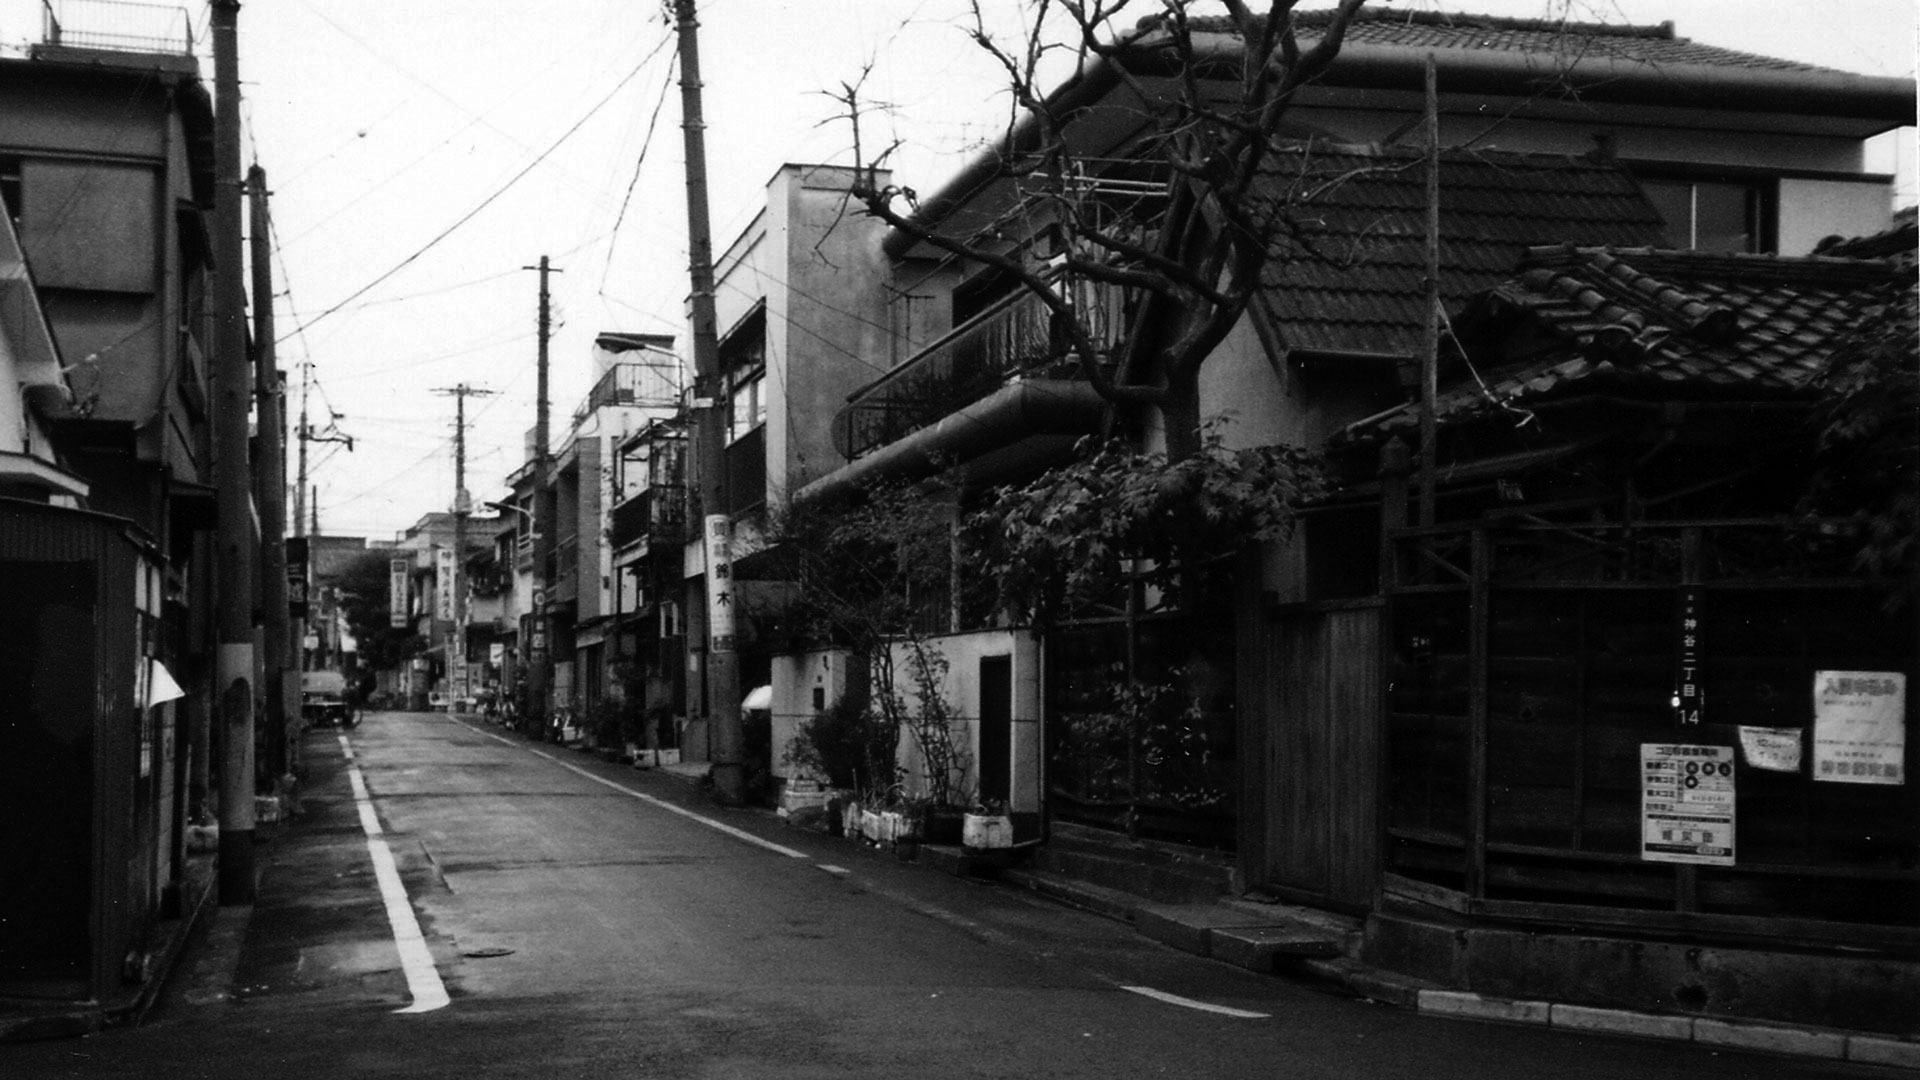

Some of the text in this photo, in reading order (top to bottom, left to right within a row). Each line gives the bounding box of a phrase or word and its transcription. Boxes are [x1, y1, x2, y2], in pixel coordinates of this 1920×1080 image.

[715, 562, 731, 607] 鈴木
[1683, 618, 1697, 697] 神谷二丁目
[1679, 709, 1699, 725] 14
